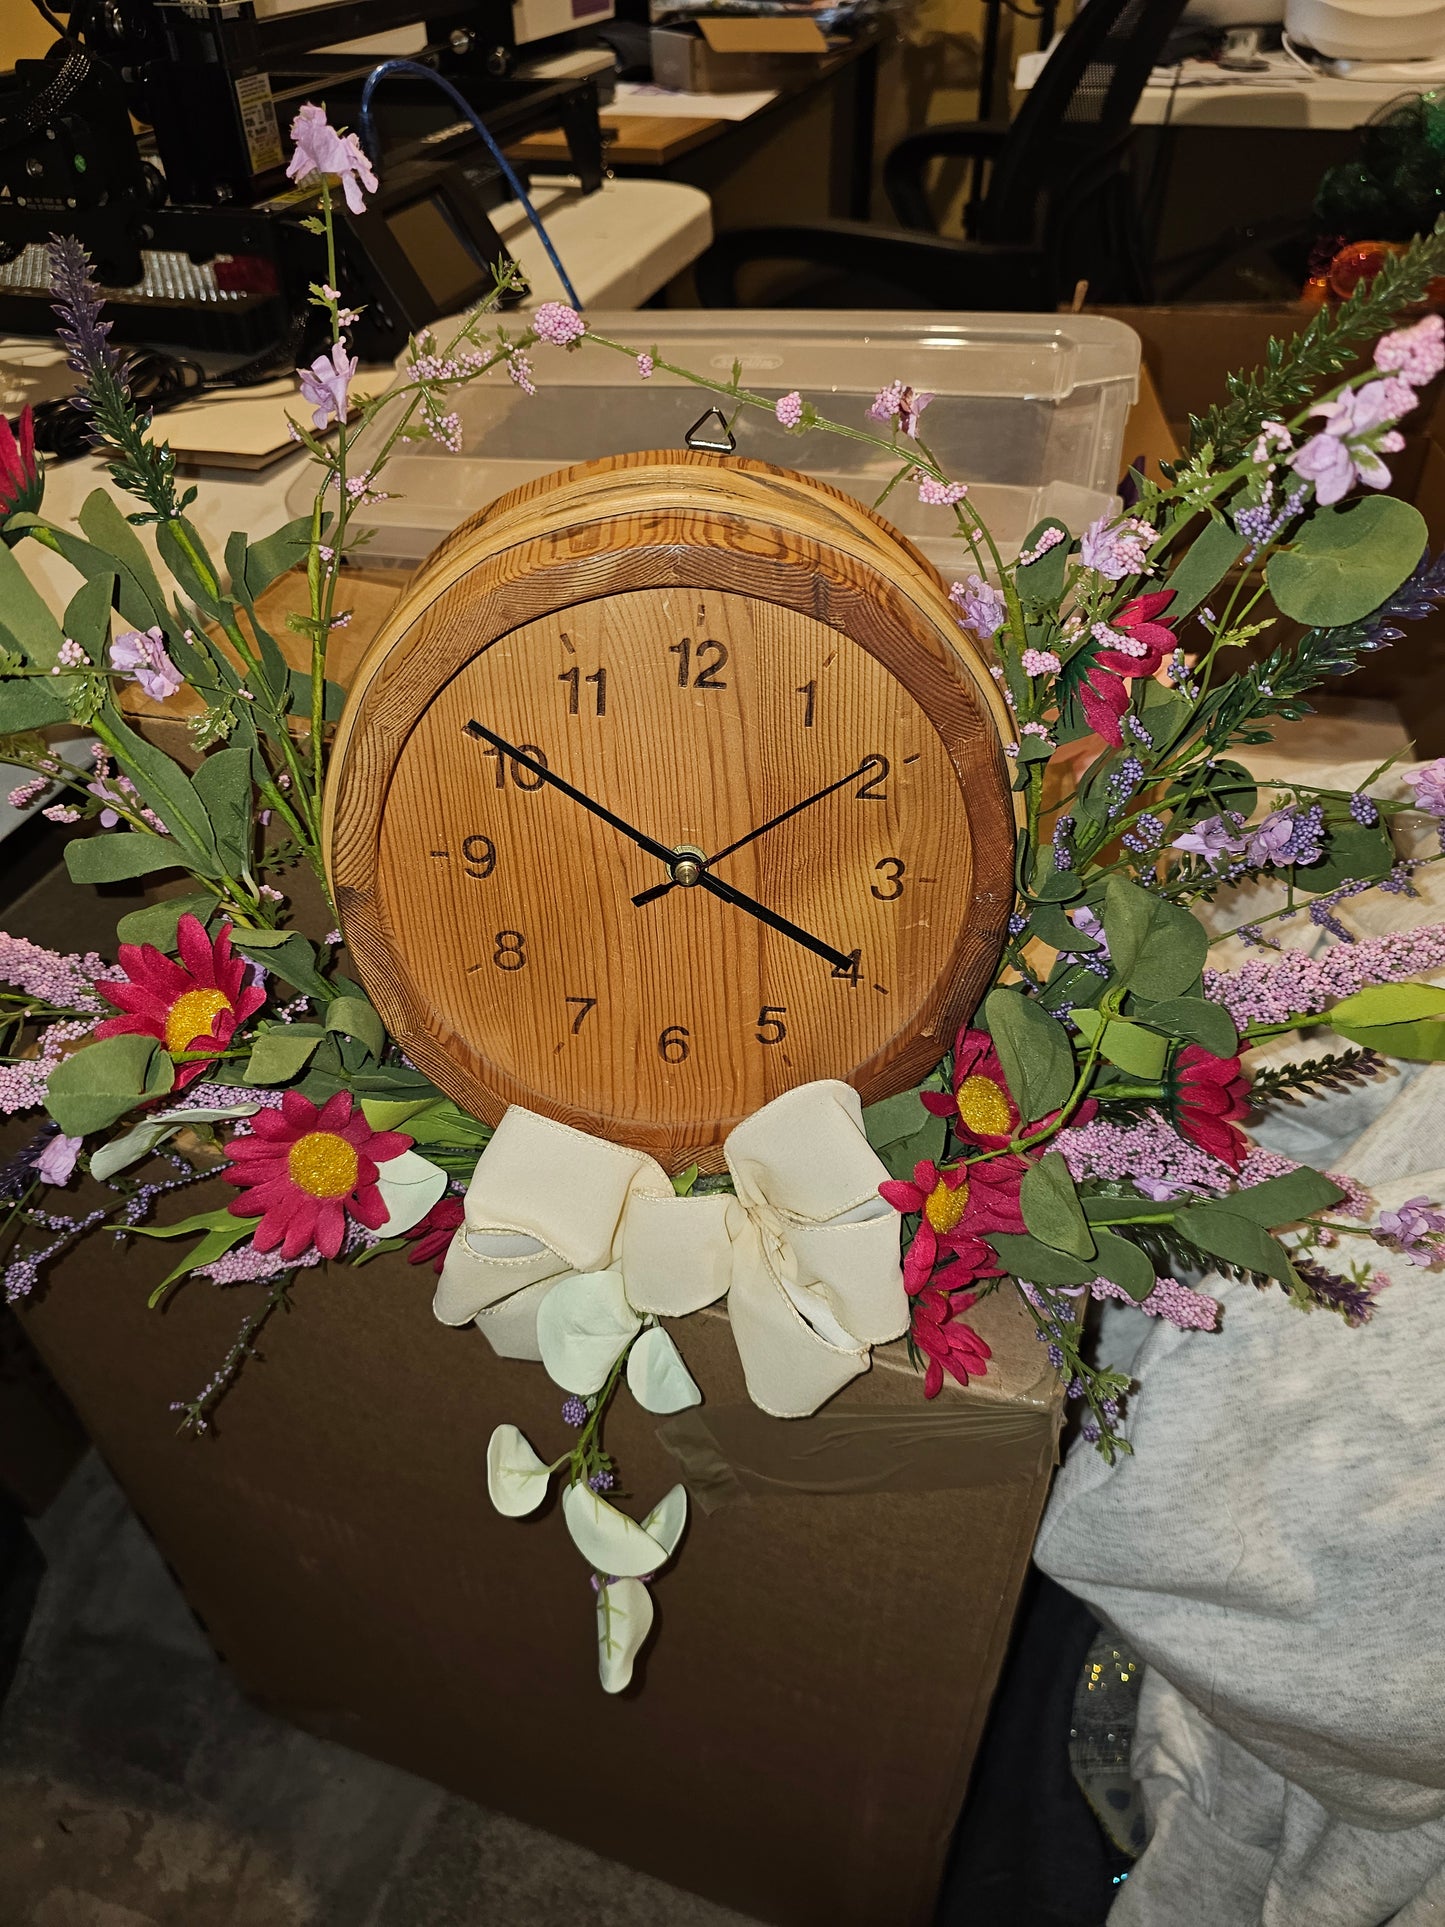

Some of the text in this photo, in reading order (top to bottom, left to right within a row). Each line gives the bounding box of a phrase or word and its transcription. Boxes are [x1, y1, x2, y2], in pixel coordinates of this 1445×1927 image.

[669, 638, 728, 689] 12
[558, 667, 606, 717] 11
[796, 680, 817, 727] 1
[483, 744, 549, 792] 10
[855, 753, 890, 800] 2
[462, 835, 496, 879] 9
[871, 857, 905, 901] 3
[493, 930, 526, 971] 8
[831, 949, 864, 988] 4
[565, 997, 597, 1034] 7
[755, 1005, 787, 1044] 5
[658, 1026, 690, 1064] 6
